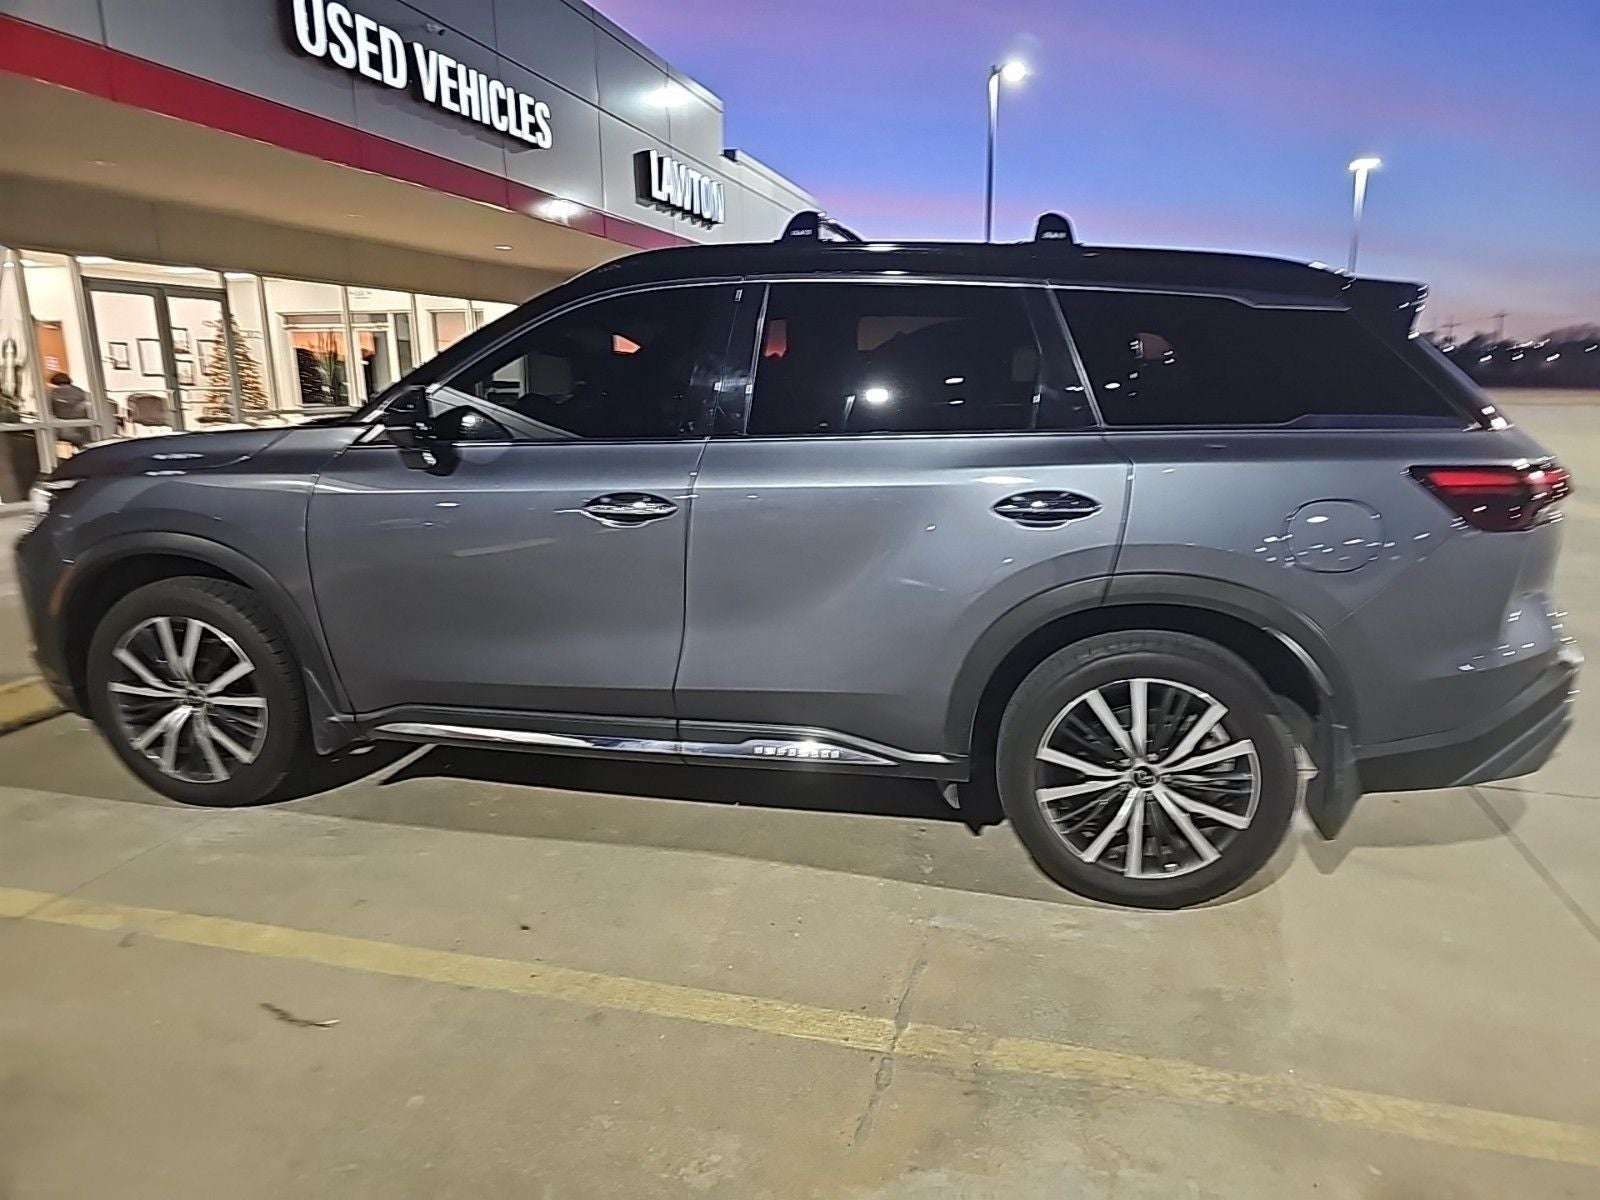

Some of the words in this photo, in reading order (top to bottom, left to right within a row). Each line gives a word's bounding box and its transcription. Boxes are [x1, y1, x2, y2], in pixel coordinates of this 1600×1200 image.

[292, 0, 408, 89] USED
[412, 41, 553, 149] VEHICLES
[649, 149, 725, 224] LAWTON
